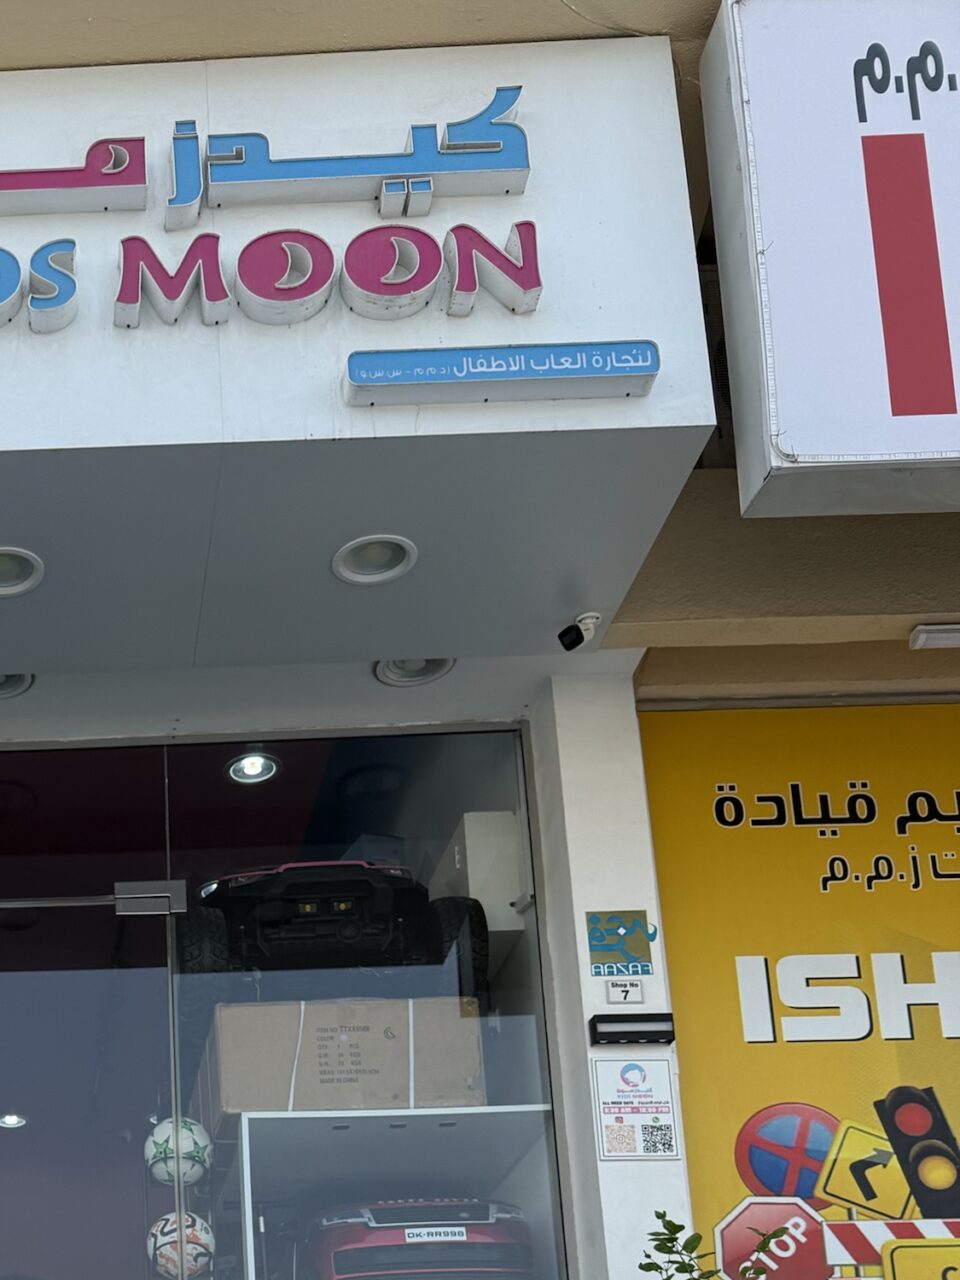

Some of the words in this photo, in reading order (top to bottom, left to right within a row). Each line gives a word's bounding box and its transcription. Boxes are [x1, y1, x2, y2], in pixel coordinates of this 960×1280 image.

[114, 219, 542, 316] MOON
[713, 780, 878, 837] قيادة
[620, 990, 629, 1001] 7
